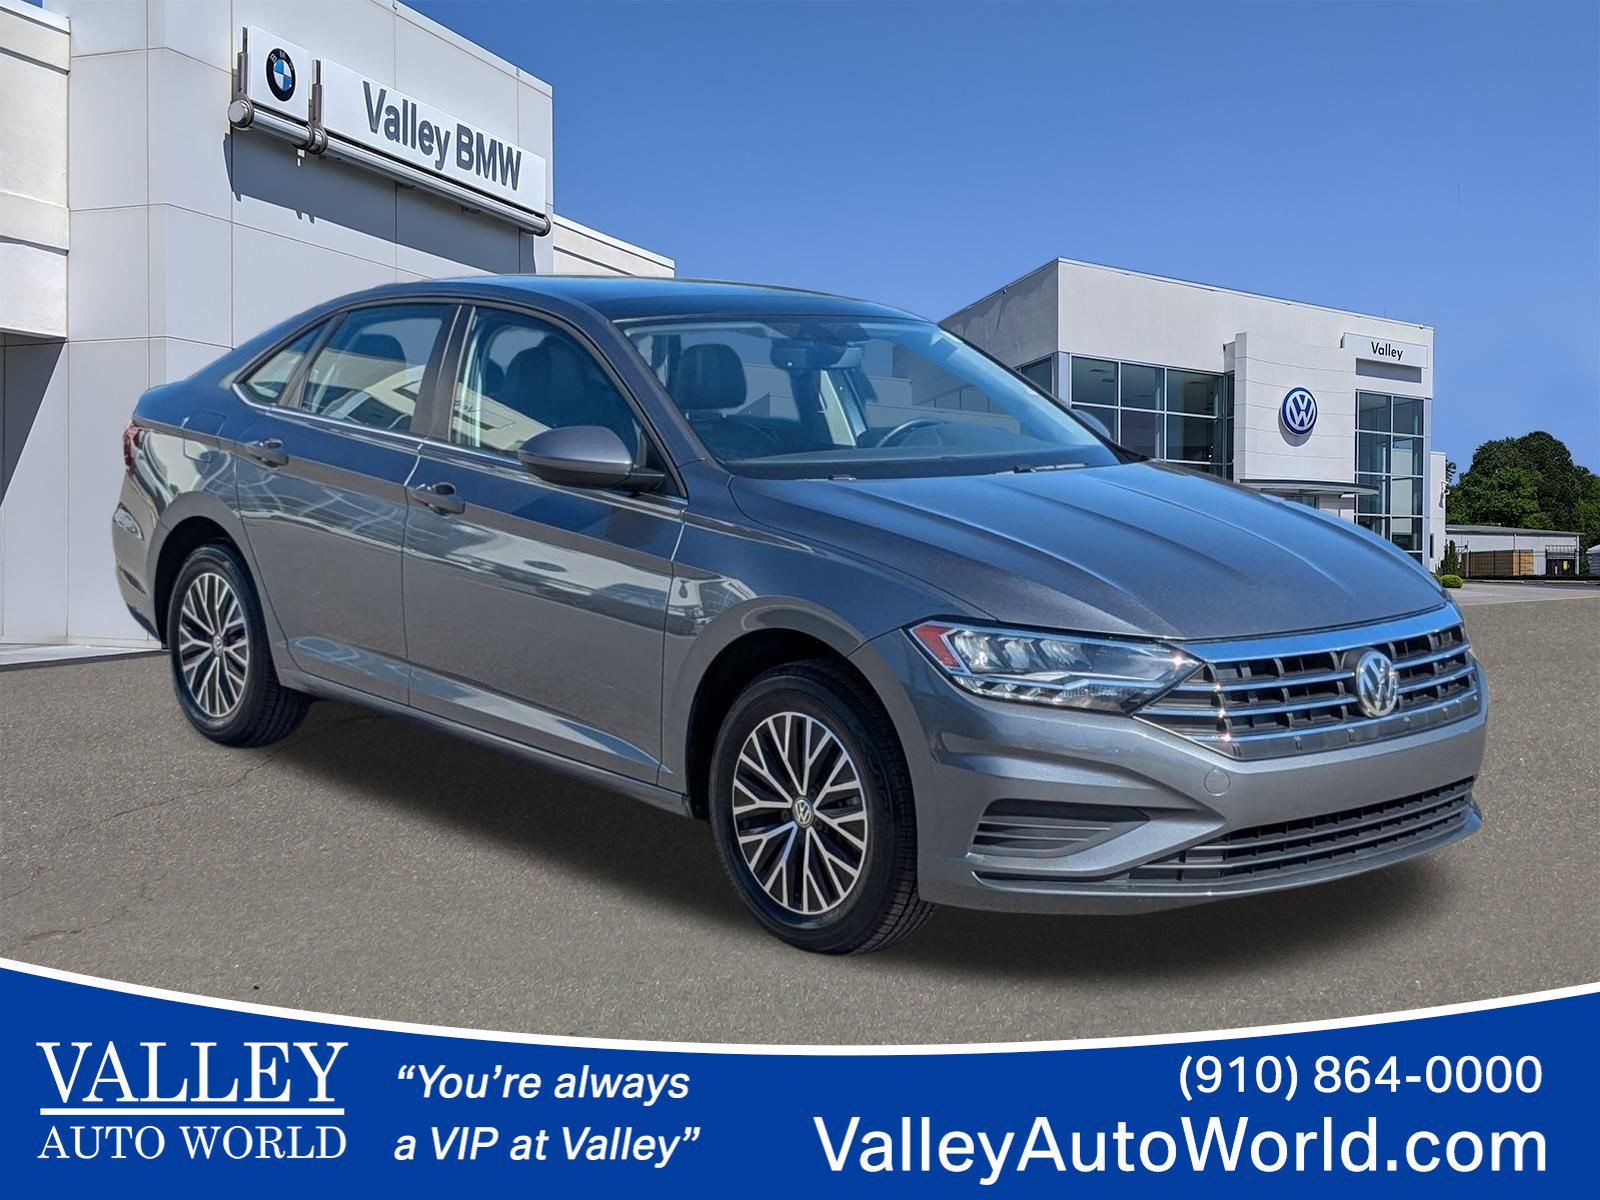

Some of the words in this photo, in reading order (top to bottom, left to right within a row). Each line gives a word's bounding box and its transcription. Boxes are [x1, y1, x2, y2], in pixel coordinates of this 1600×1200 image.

[362, 80, 451, 171] Valley
[456, 123, 522, 191] BMW
[1371, 341, 1403, 361] Valley
